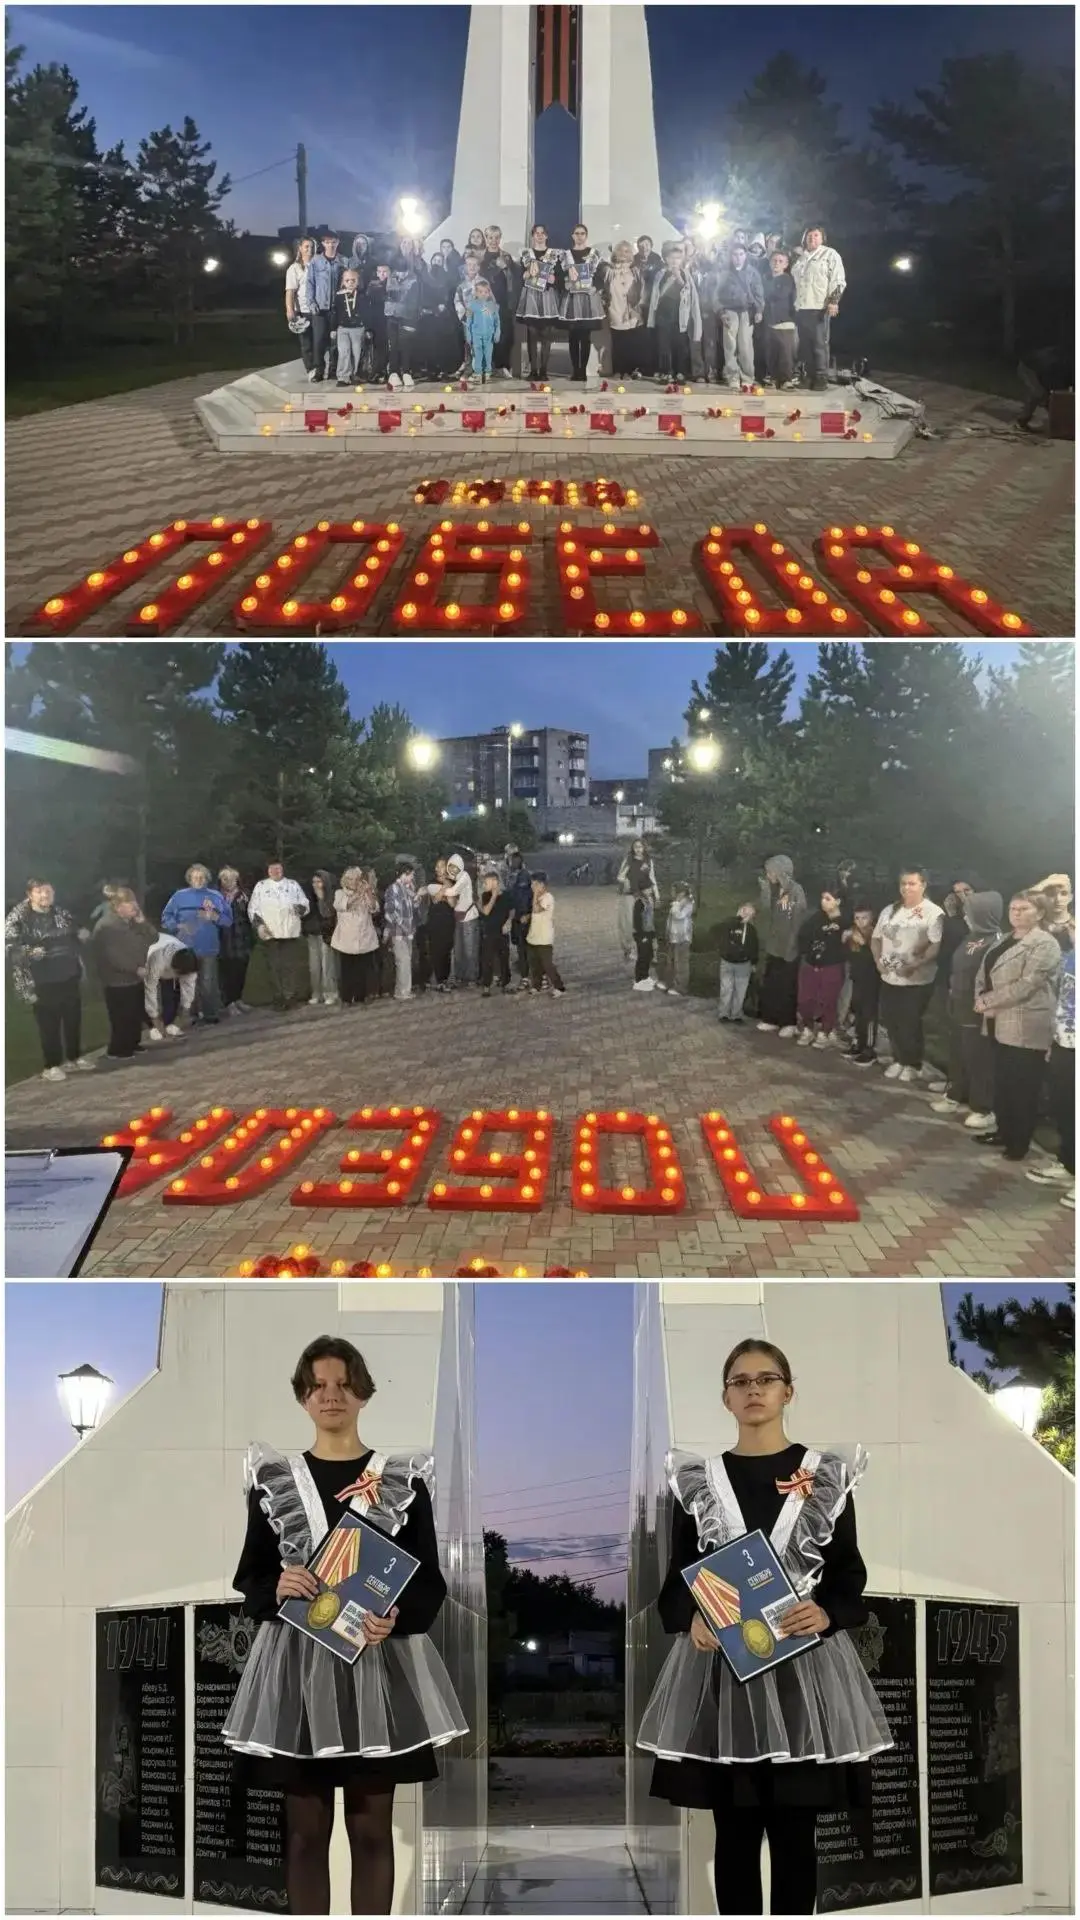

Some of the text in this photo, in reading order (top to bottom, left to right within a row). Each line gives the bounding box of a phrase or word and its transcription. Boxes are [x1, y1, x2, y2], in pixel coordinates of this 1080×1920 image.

[20, 516, 1034, 637] ПОБЕДА
[384, 1557, 397, 1574] 3
[742, 1549, 754, 1567] 3
[106, 1616, 170, 1670] 1941
[936, 1609, 1008, 1663] 1945
[247, 1828, 269, 1838] Иванов
